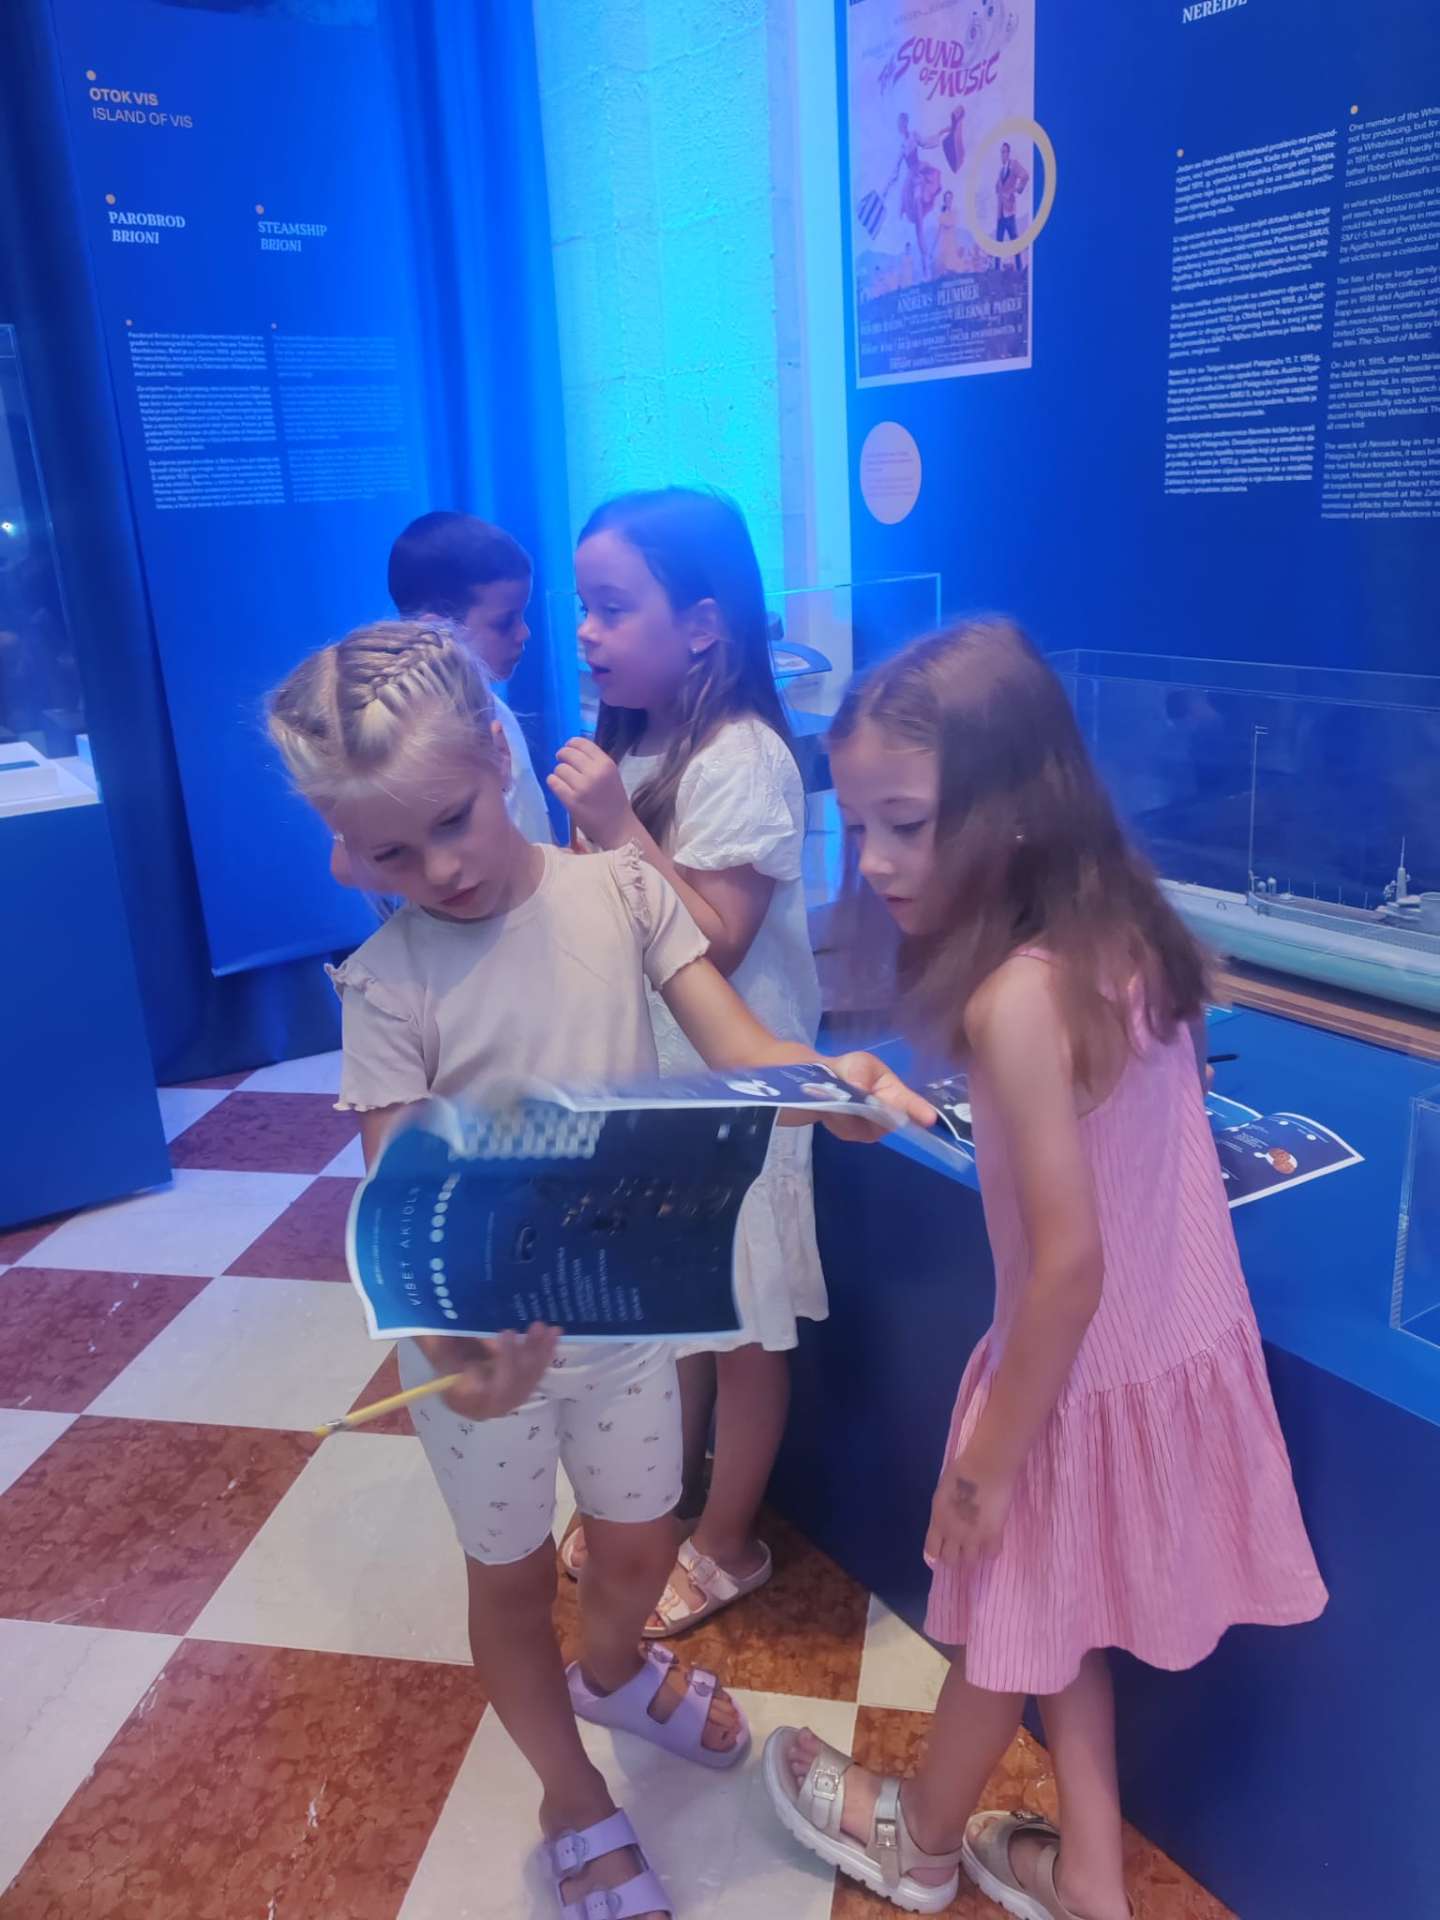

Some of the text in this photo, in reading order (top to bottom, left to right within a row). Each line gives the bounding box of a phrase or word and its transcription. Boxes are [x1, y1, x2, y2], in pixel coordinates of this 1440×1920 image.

[893, 36, 965, 86] SOUND
[919, 66, 938, 85] OF
[926, 51, 1000, 101] MUSIC
[89, 87, 159, 106] OTOK VIS
[92, 107, 193, 128] ISLAND OF VIS
[108, 211, 186, 228] PAROBROD
[257, 220, 328, 237] STEAMSHIP
[112, 229, 160, 244] BRIONI
[260, 238, 302, 252] BRIONI
